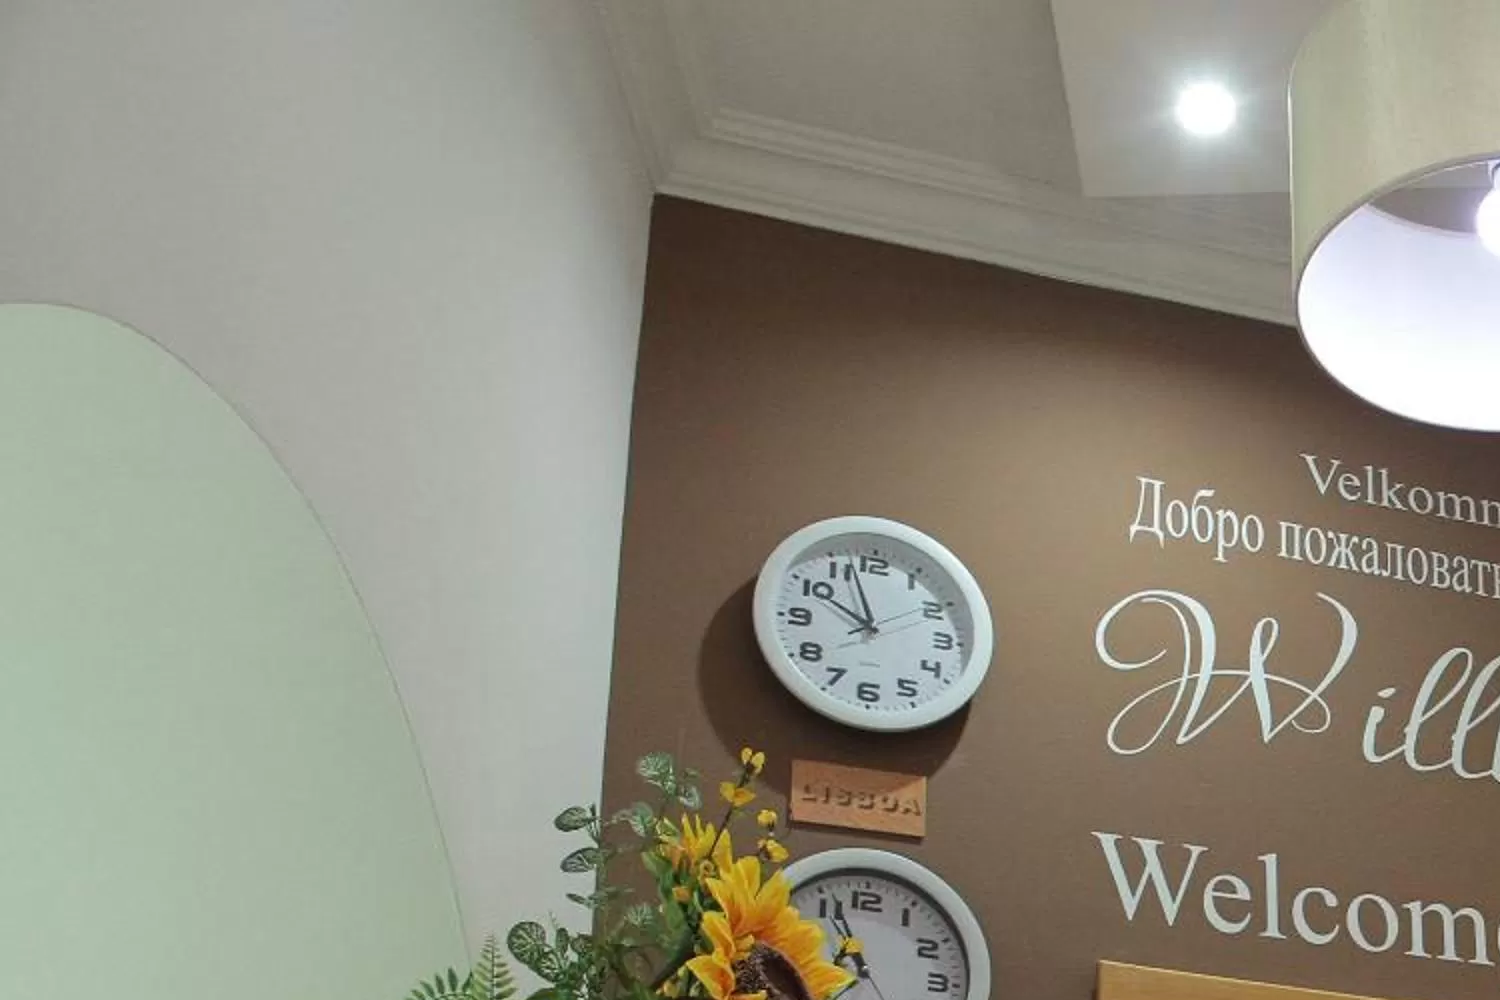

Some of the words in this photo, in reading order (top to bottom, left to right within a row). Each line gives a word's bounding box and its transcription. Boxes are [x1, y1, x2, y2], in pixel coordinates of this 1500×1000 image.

[1130, 476, 1264, 562] Добро
[830, 562, 853, 581] 11
[860, 555, 889, 576] 12
[803, 579, 834, 600] 10
[906, 574, 916, 590] 1
[788, 607, 812, 626] 9
[922, 601, 944, 621] 2
[933, 632, 954, 651] 3
[800, 642, 823, 662] 8
[826, 667, 848, 686] 7
[920, 660, 941, 678] 4
[857, 682, 880, 702] 6
[896, 678, 918, 698] 5
[819, 898, 843, 920] 11
[852, 890, 882, 912] 12
[901, 908, 910, 927] 1
[916, 937, 939, 960] 2
[928, 972, 949, 993] 3
